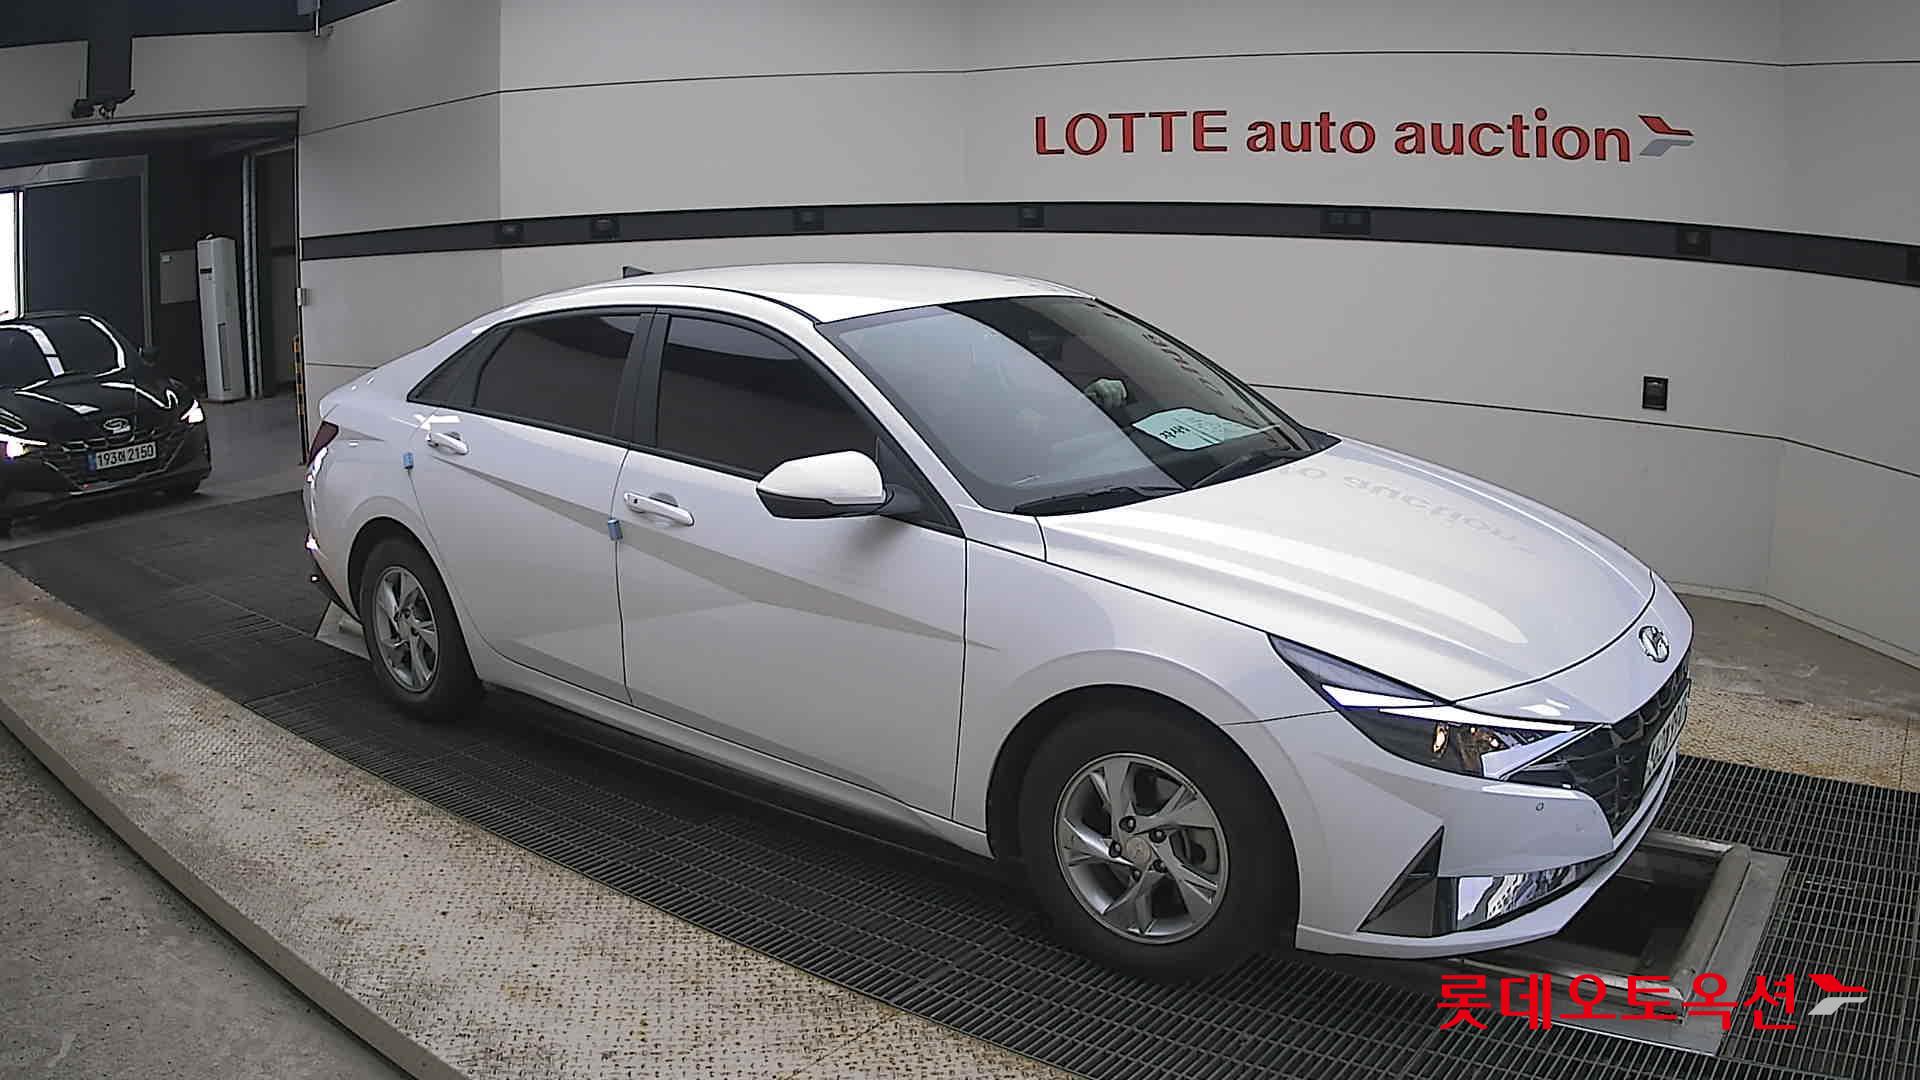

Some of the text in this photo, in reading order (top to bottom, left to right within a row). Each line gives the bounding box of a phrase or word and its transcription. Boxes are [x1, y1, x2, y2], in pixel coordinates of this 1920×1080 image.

[1035, 107, 1630, 162] LOTTE auto auction
[128, 445, 153, 460] 2150
